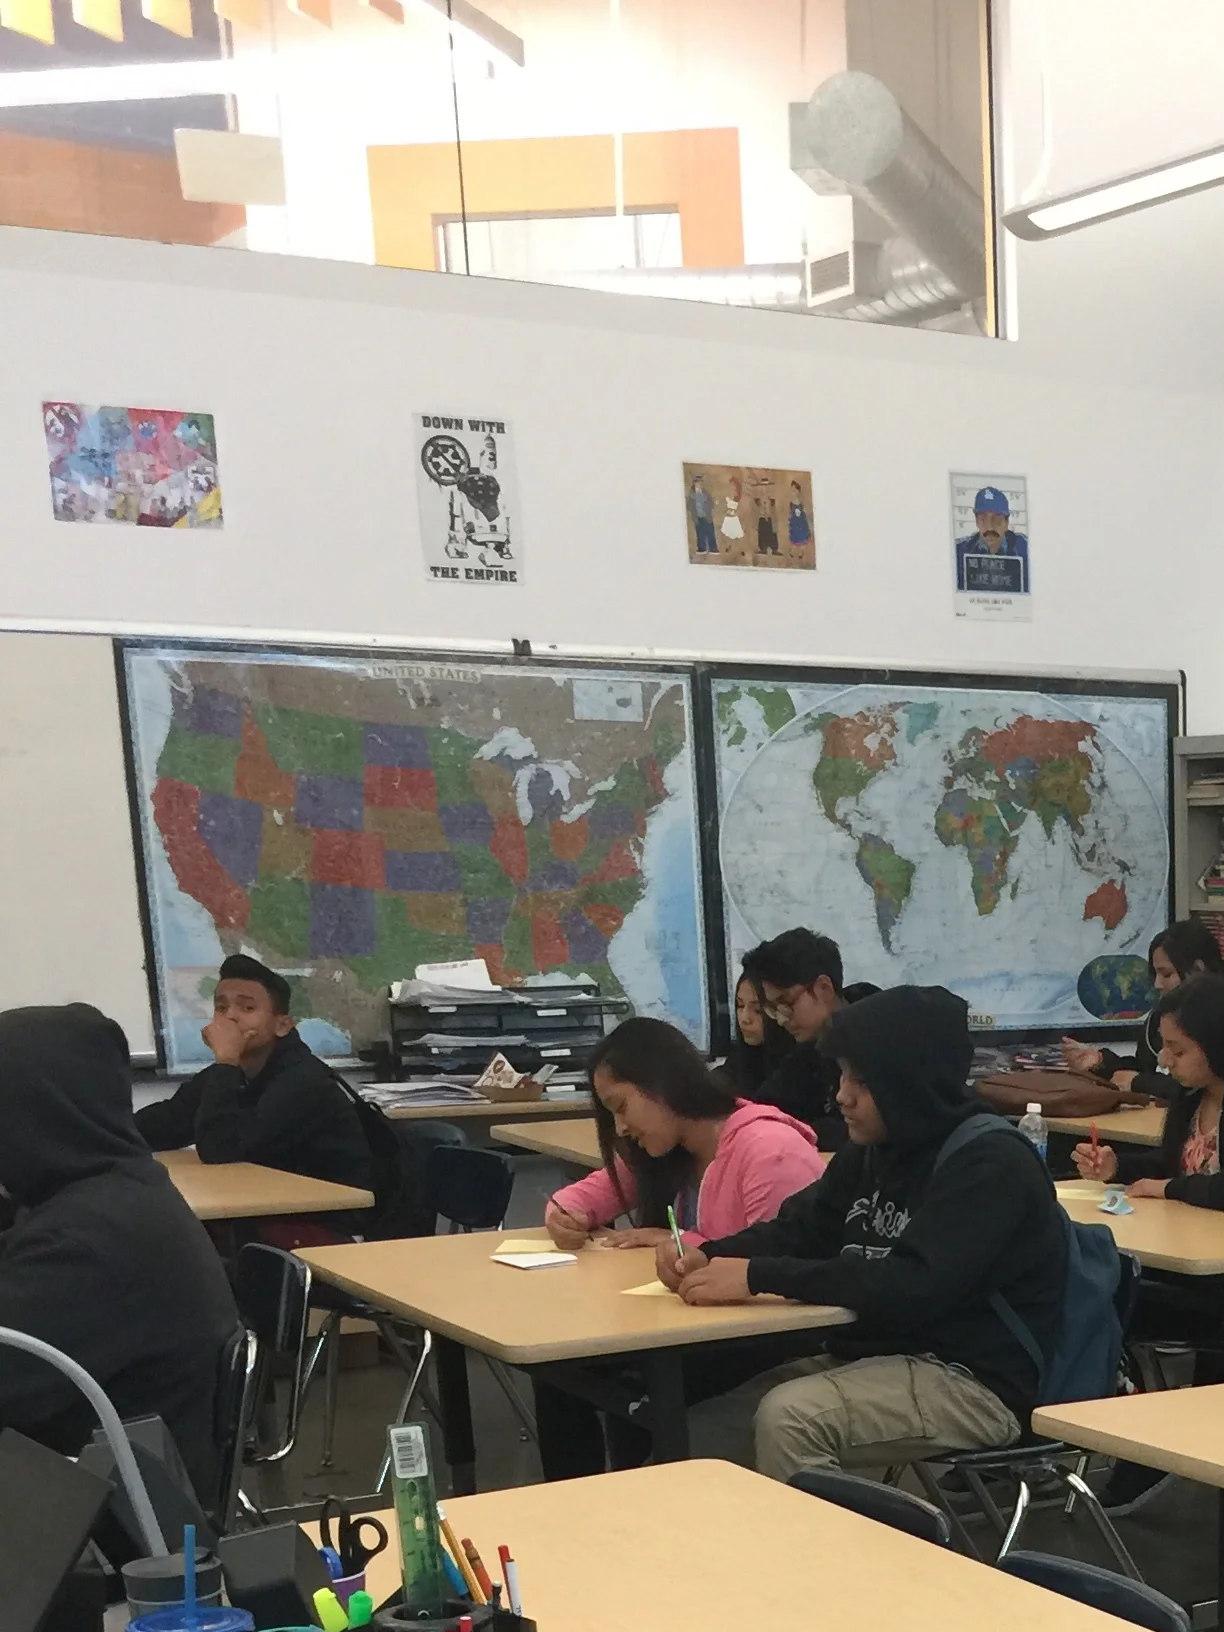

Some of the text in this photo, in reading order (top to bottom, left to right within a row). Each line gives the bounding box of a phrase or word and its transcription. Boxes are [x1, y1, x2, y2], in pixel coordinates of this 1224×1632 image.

[421, 415, 506, 434] DOWN WITH
[429, 566, 518, 583] THE EMPIRE
[372, 665, 478, 682] UNITED STATES
[967, 1015, 993, 1025] ORLD
